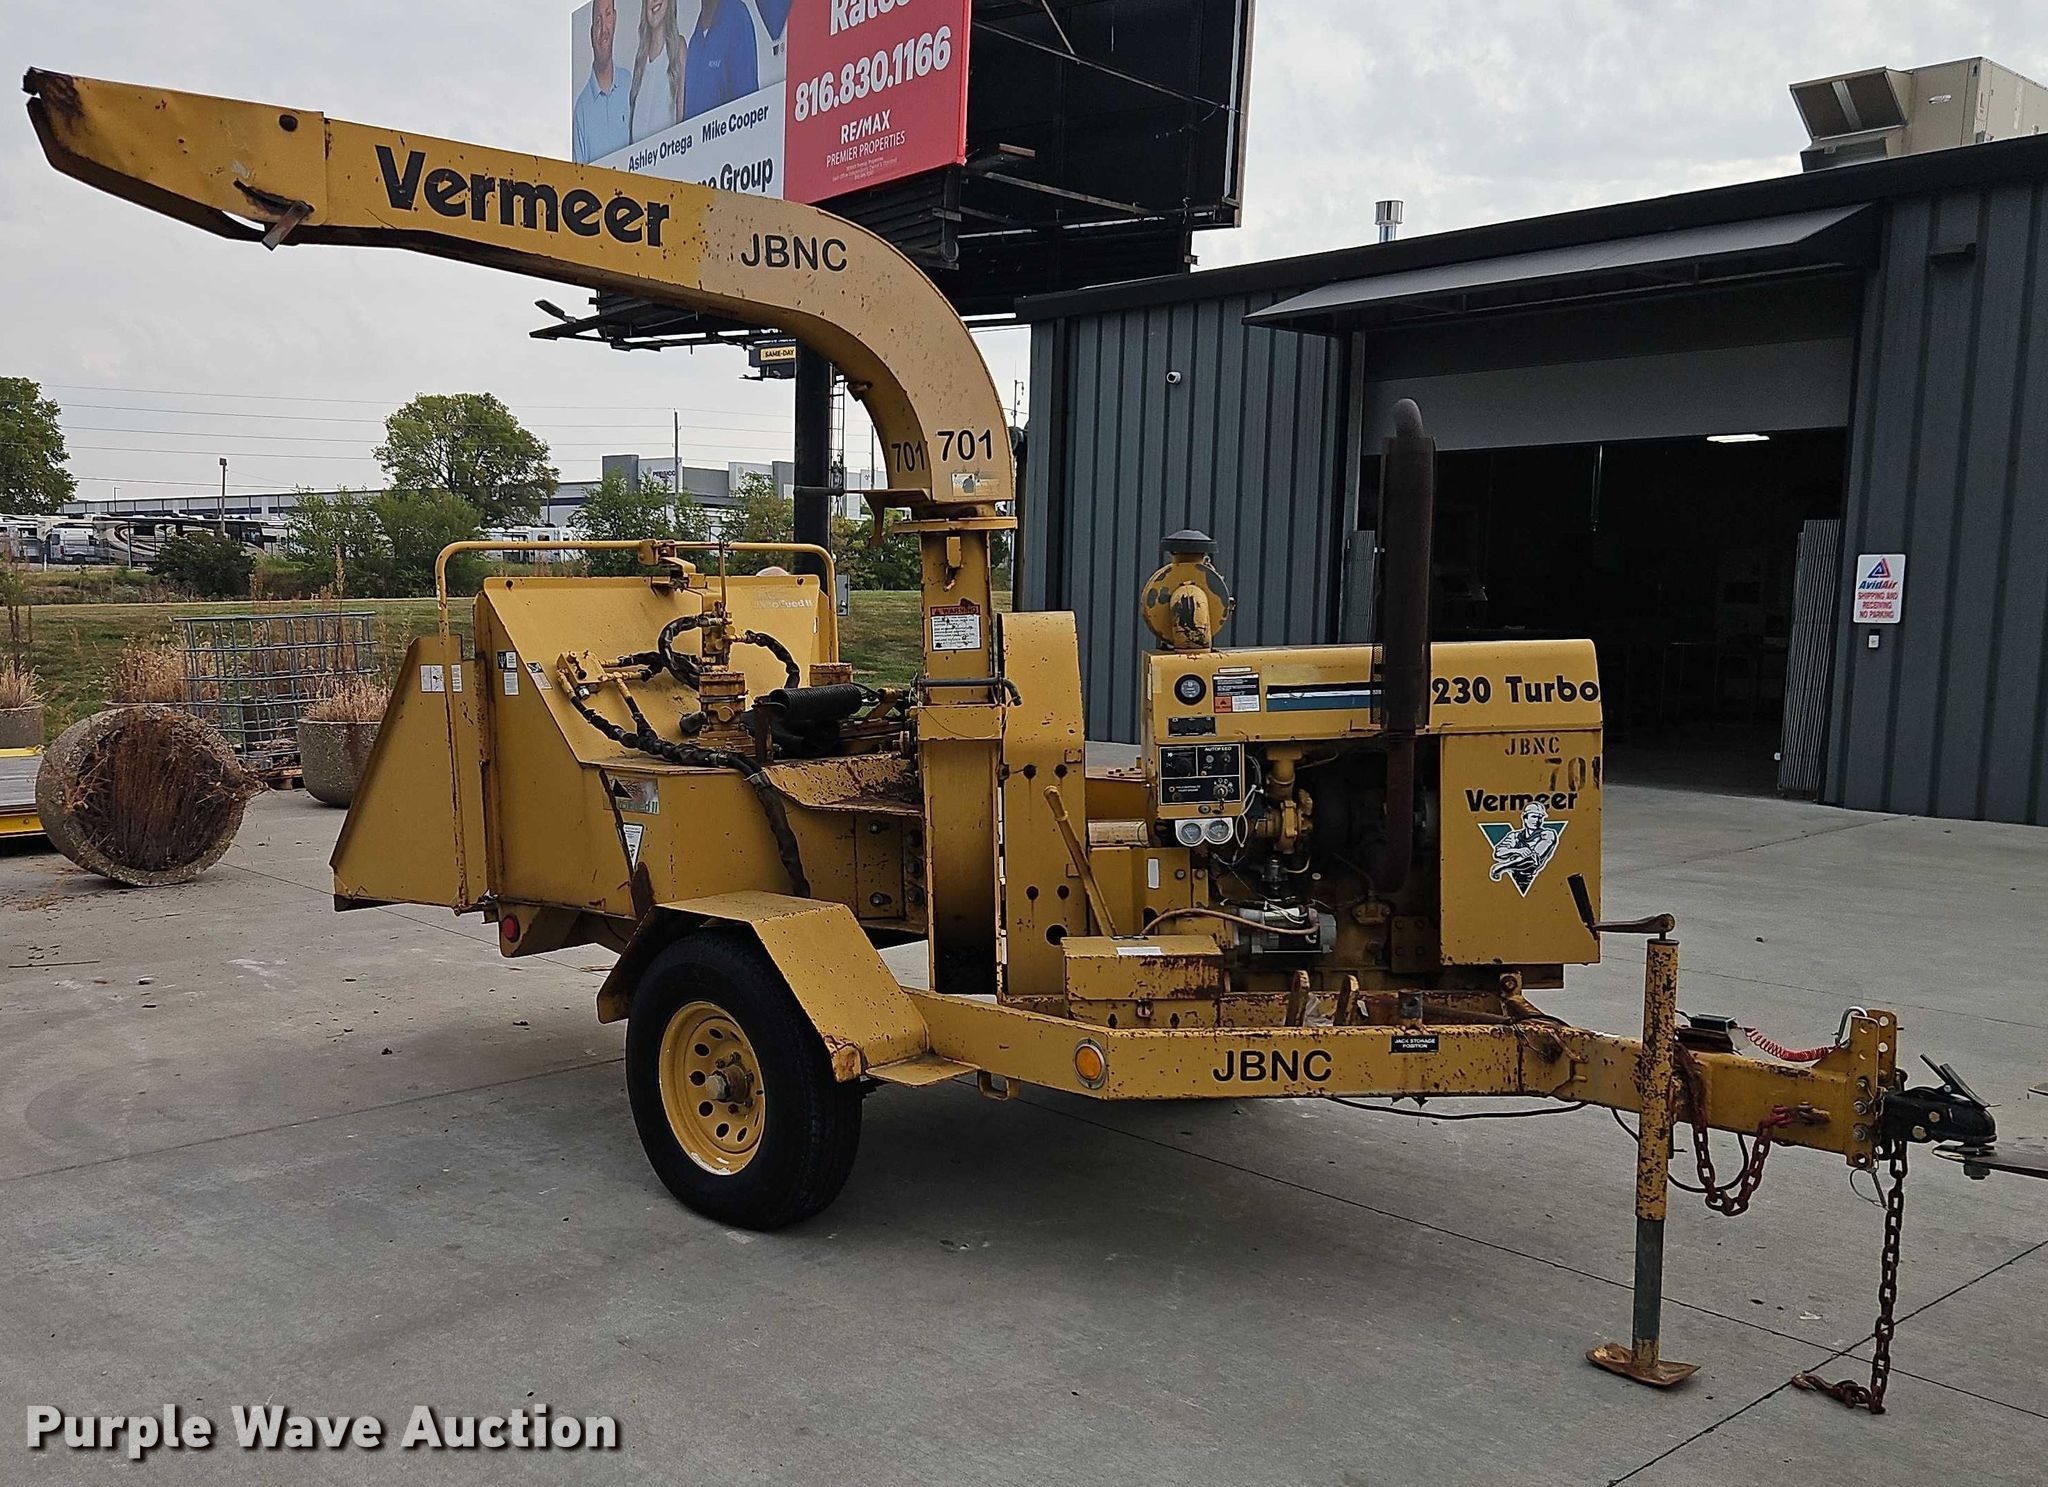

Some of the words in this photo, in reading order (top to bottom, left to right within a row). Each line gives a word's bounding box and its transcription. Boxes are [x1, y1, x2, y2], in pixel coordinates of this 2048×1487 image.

[830, 0, 909, 36] Rate
[795, 25, 952, 121] 816.830.1166
[628, 148, 659, 172] Ashley
[659, 135, 693, 159] Ortega
[702, 118, 727, 143] Mike
[728, 105, 769, 132] Cooper
[841, 109, 891, 145] RE/MAX
[826, 146, 858, 168] PREMIER
[859, 130, 906, 158] PROPERTIES
[720, 158, 774, 193] Group
[375, 143, 670, 248] Vermeer
[740, 233, 848, 272] JBNC
[891, 440, 926, 473] 701
[937, 428, 993, 462] 701
[1858, 580, 1898, 589] AvidAir
[942, 606, 977, 615] WARNG
[1432, 676, 1491, 704] 230
[1505, 674, 1600, 703] Turbo
[1504, 736, 1560, 756] JBNC
[1465, 789, 1578, 812] Vermeer
[1212, 1049, 1333, 1082] JBNC
